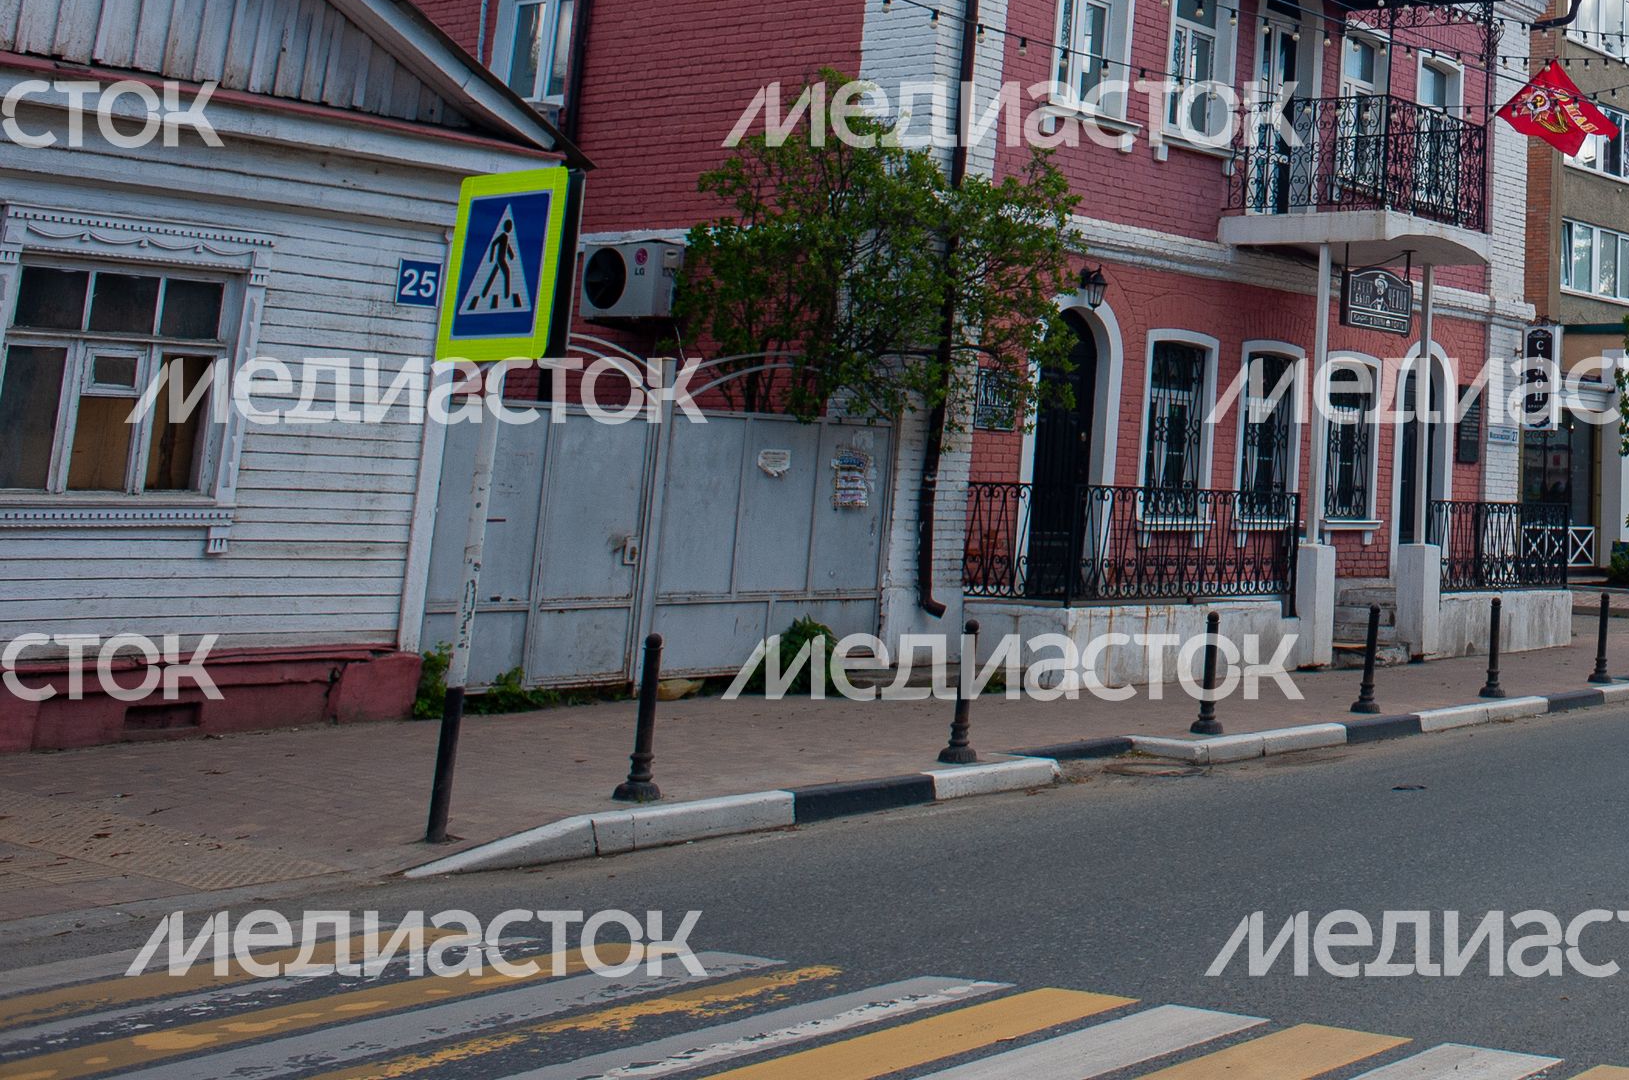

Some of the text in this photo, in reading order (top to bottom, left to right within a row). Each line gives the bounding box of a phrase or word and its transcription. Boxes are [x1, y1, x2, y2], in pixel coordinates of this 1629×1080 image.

[635, 268, 645, 276] LG
[401, 268, 436, 298] 25
[1535, 340, 1545, 401] САЛОН
[1512, 431, 1518, 442] 27
